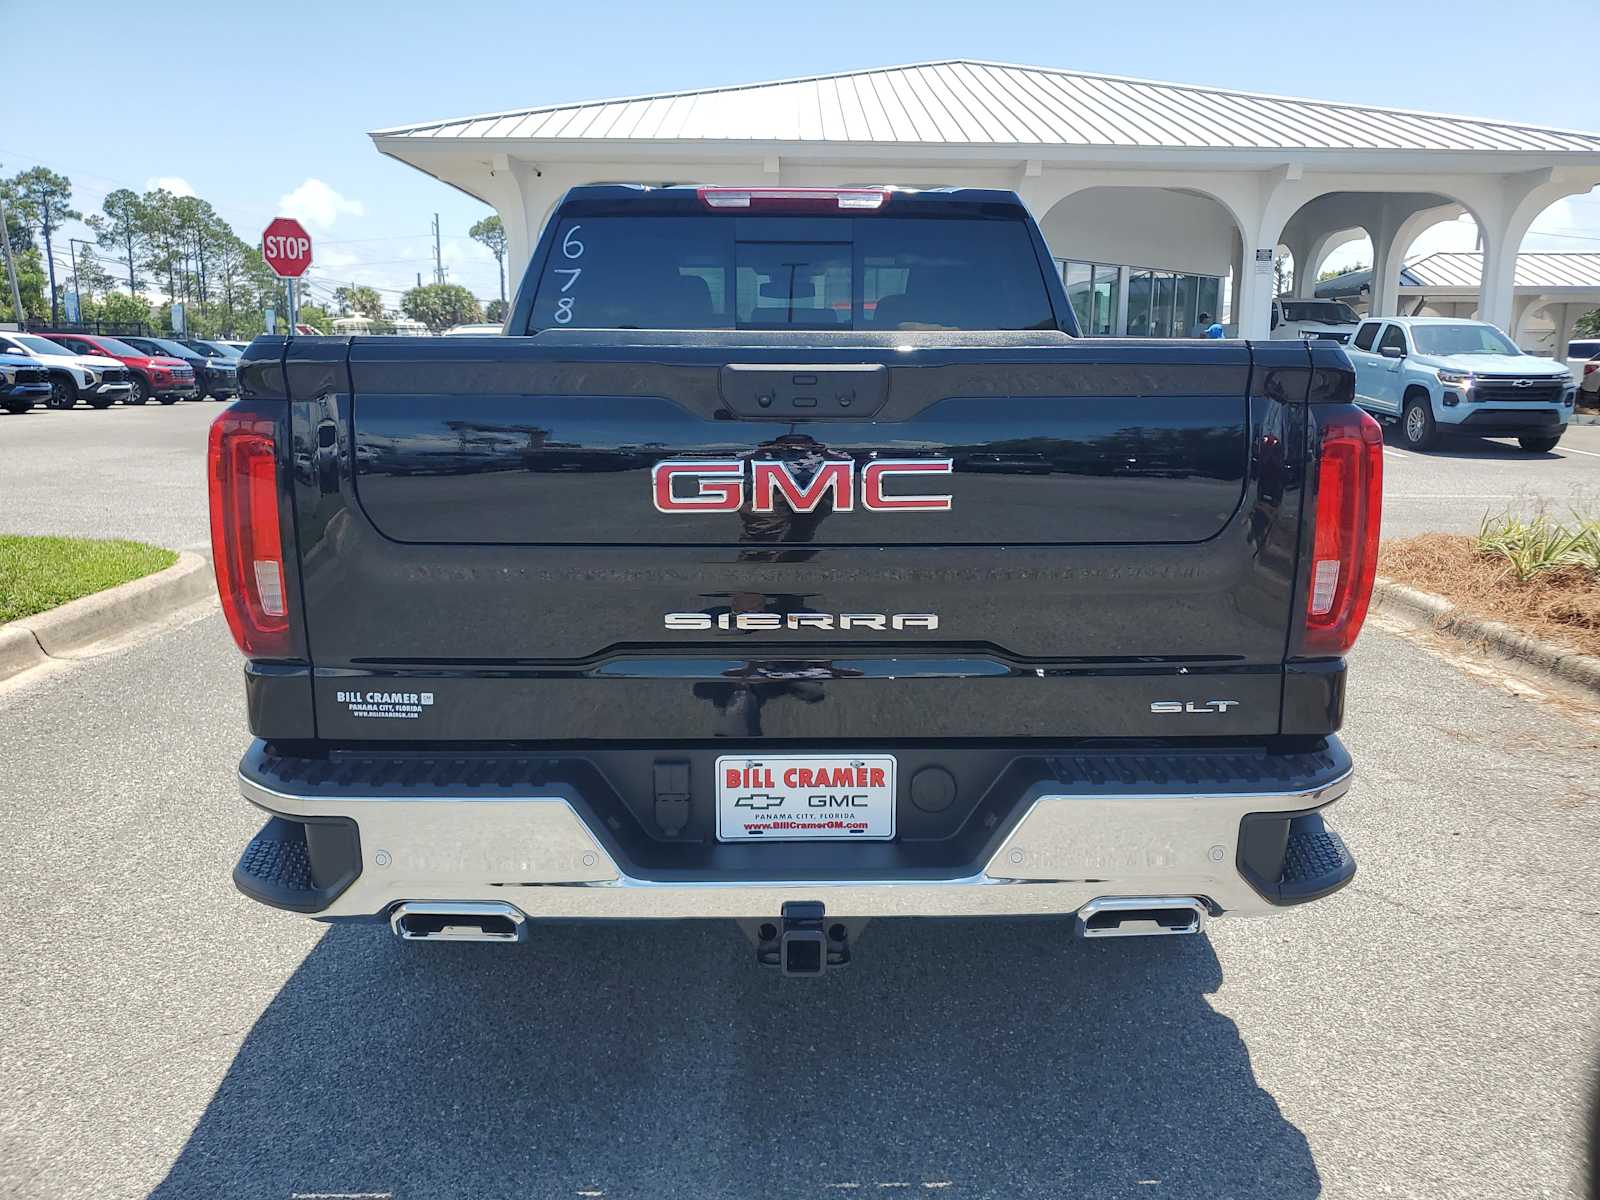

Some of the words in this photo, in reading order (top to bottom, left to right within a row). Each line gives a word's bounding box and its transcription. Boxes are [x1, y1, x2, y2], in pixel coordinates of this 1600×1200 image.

[266, 235, 310, 261] STOP
[651, 458, 954, 514] GMC
[664, 612, 939, 631] SIERRA
[336, 692, 362, 702] BILL
[366, 692, 419, 704] CRAMER
[1150, 700, 1240, 713] SLT
[726, 768, 776, 789] BILL
[783, 767, 886, 789] CRAMER
[808, 795, 868, 808] GMC
[744, 821, 868, 831] www.BillCramerGM.com
